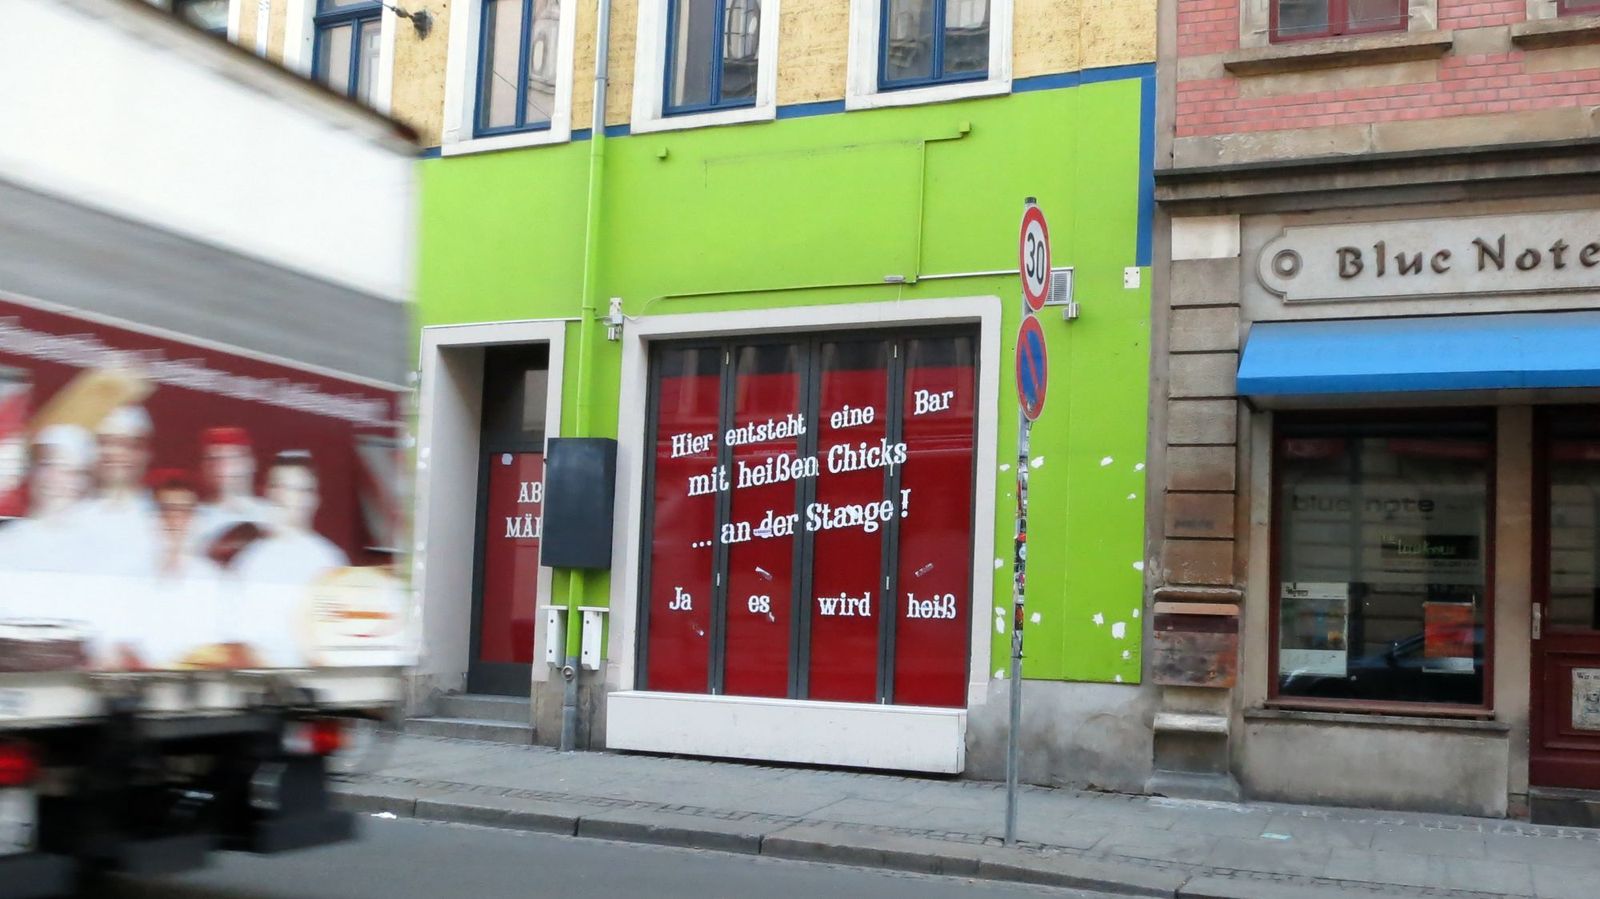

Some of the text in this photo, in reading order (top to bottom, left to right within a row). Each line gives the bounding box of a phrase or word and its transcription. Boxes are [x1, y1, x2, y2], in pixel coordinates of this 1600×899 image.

[1027, 232, 1045, 285] 30
[1336, 233, 1600, 279] Blue Note
[670, 389, 954, 458] Hier entsteht eine Bar
[687, 437, 907, 496] mit heißen Chicks
[720, 522, 751, 545] an
[759, 511, 799, 538] der
[806, 497, 894, 533] Stange
[669, 586, 956, 619] Ja es wird heiß
